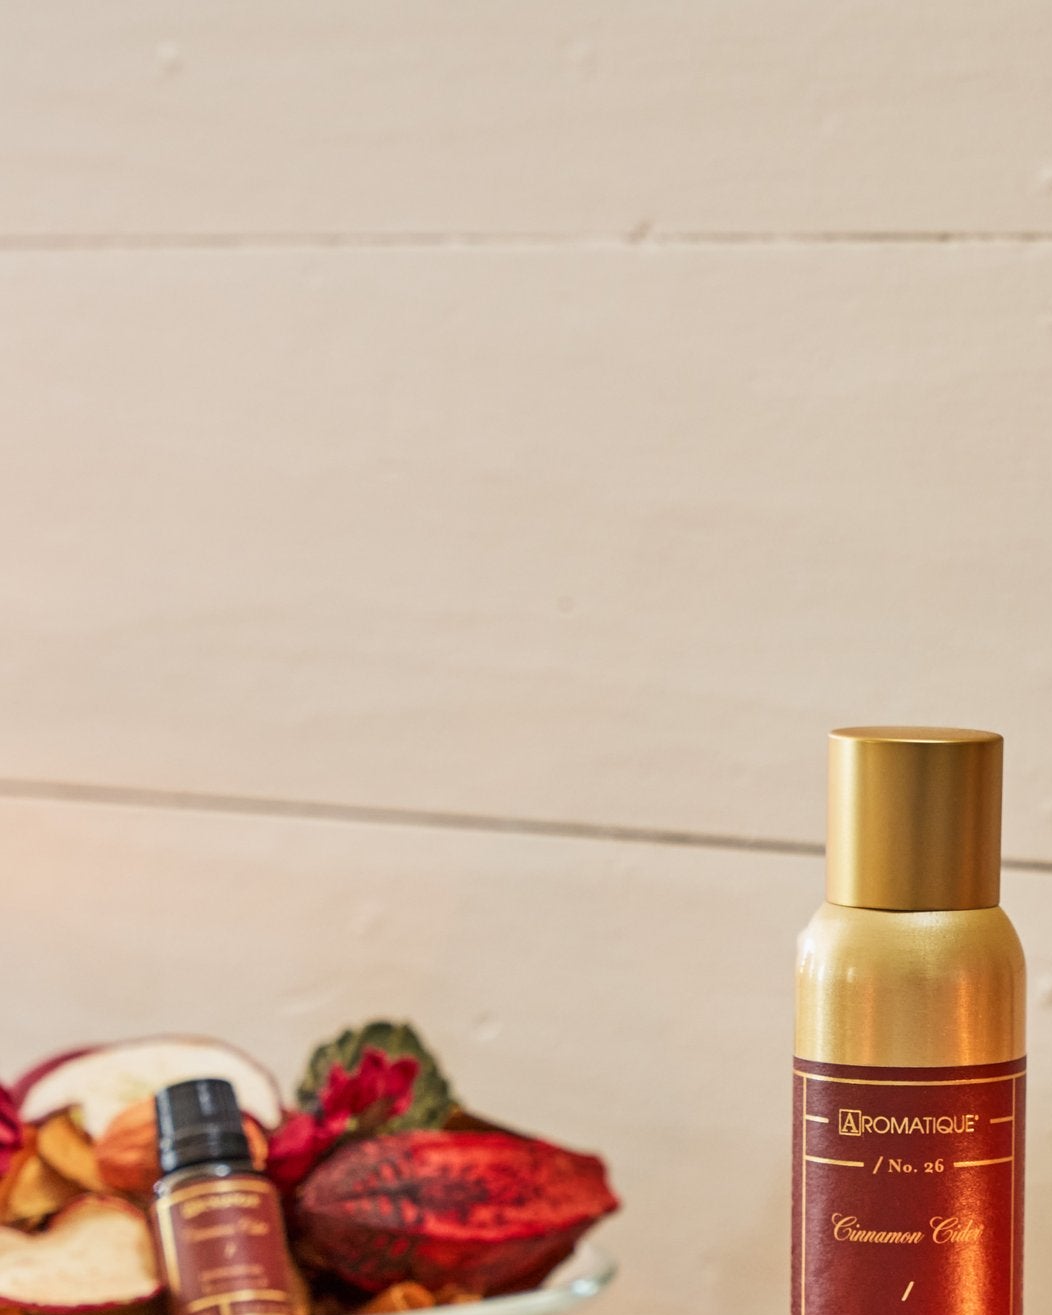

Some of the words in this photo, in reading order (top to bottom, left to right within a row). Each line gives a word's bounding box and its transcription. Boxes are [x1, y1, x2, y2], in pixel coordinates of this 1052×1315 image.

[888, 1159, 918, 1173] No.
[924, 1158, 944, 1173] 26
[831, 1212, 925, 1244] Cinnamon
